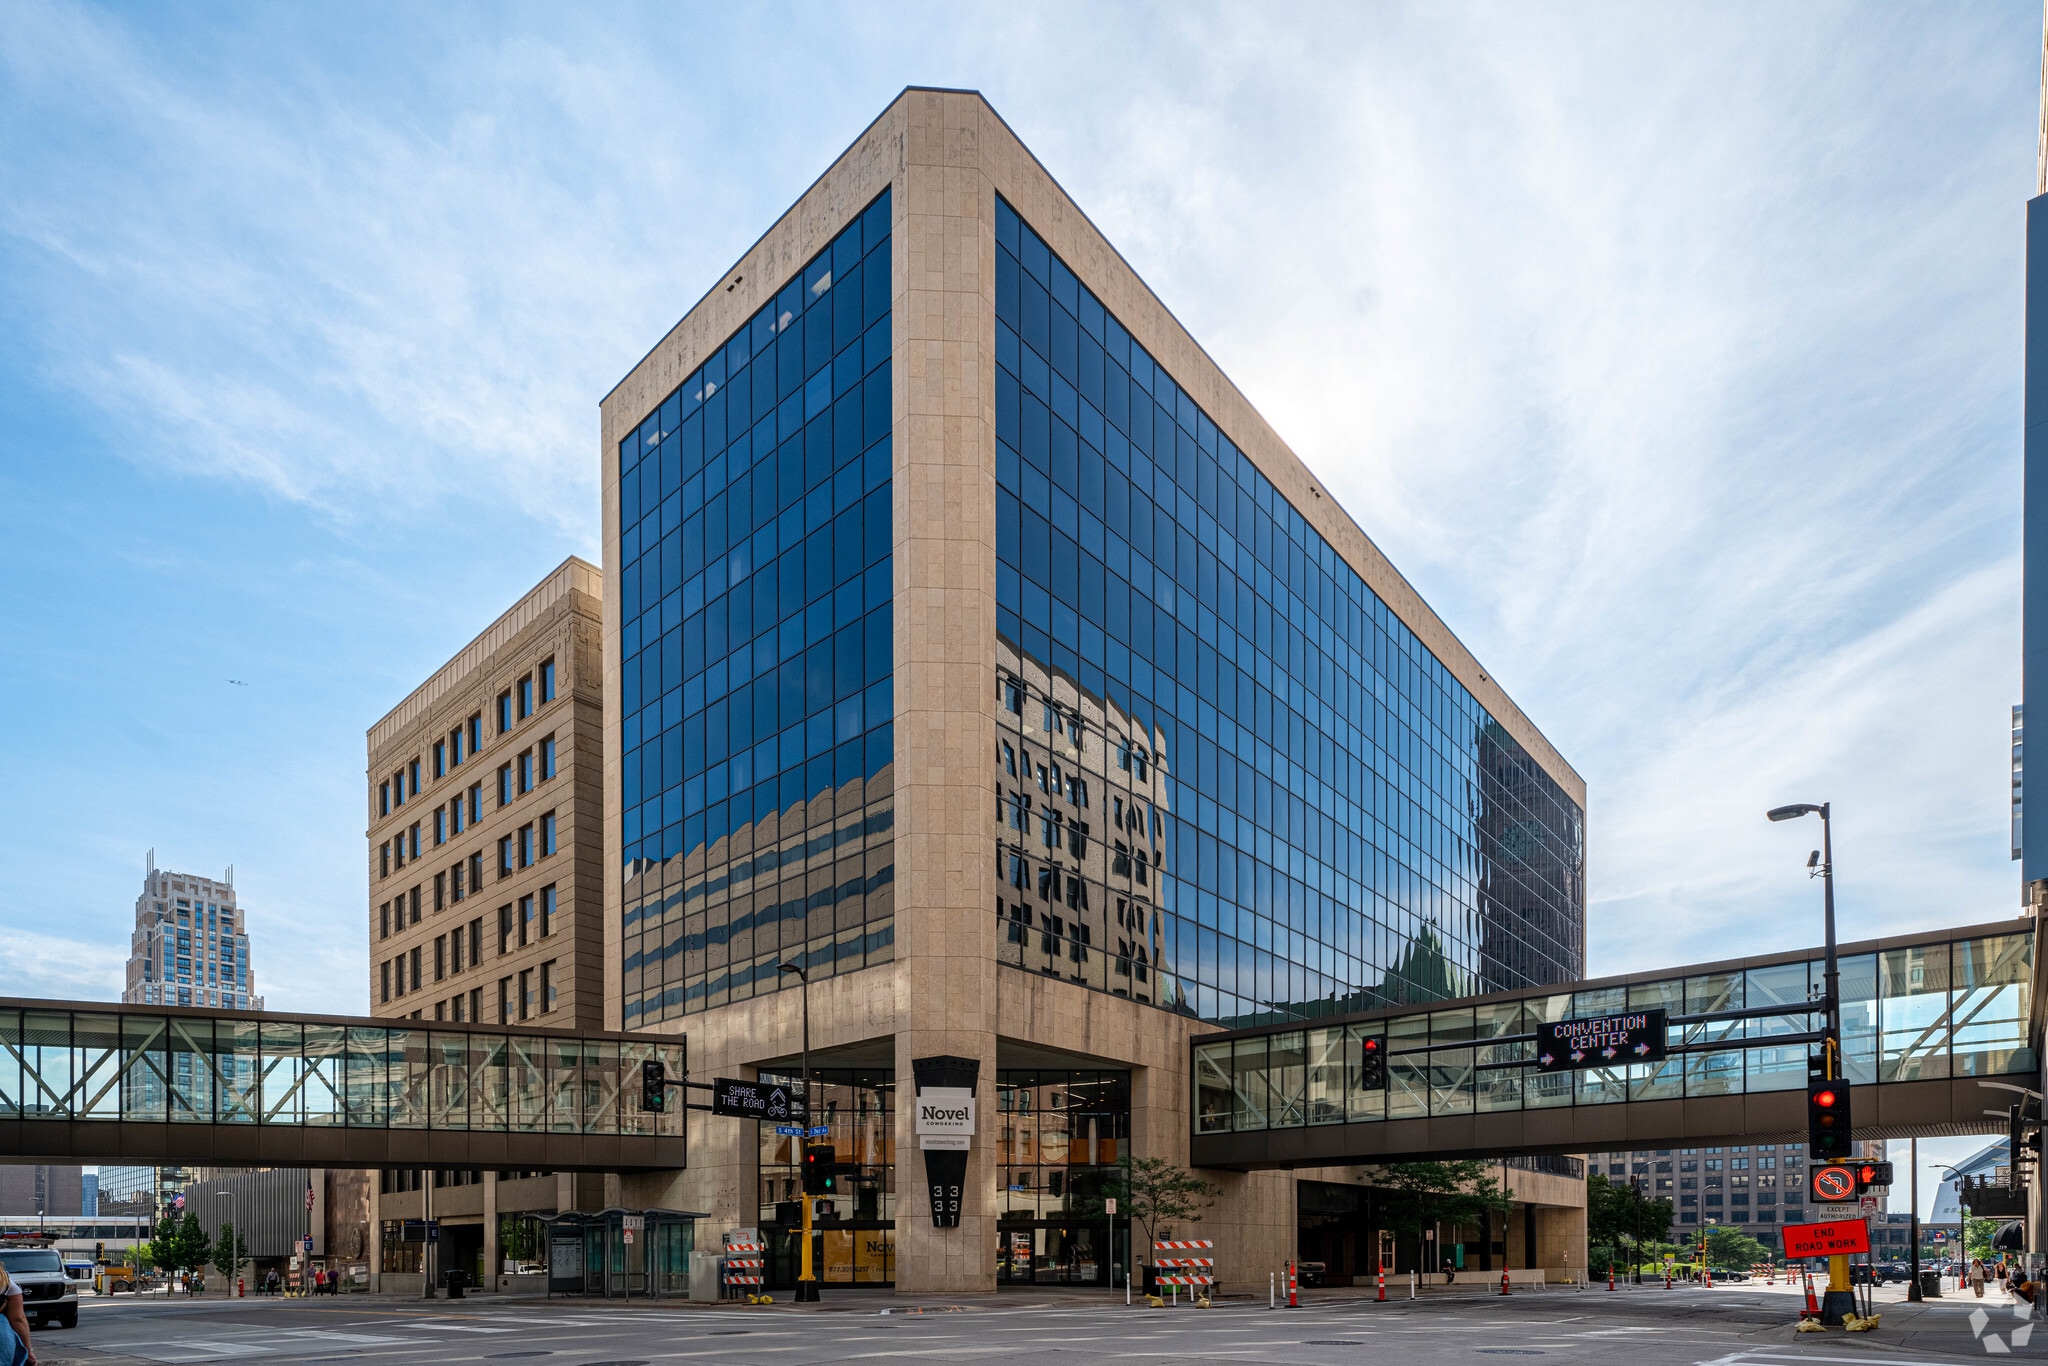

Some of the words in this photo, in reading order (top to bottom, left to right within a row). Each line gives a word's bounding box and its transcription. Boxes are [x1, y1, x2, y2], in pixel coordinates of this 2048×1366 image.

[1554, 1015, 1646, 1038] CONVENTION
[1570, 1030, 1629, 1050] CENTER
[729, 1085, 757, 1098] SHARE
[721, 1095, 738, 1106] THE
[743, 1097, 765, 1109] ROAD
[922, 1106, 969, 1120] Novel
[1814, 1229, 1834, 1238] END
[866, 1241, 895, 1252] Nov
[1796, 1242, 1822, 1251] ROAD
[1828, 1239, 1856, 1248] WORK
